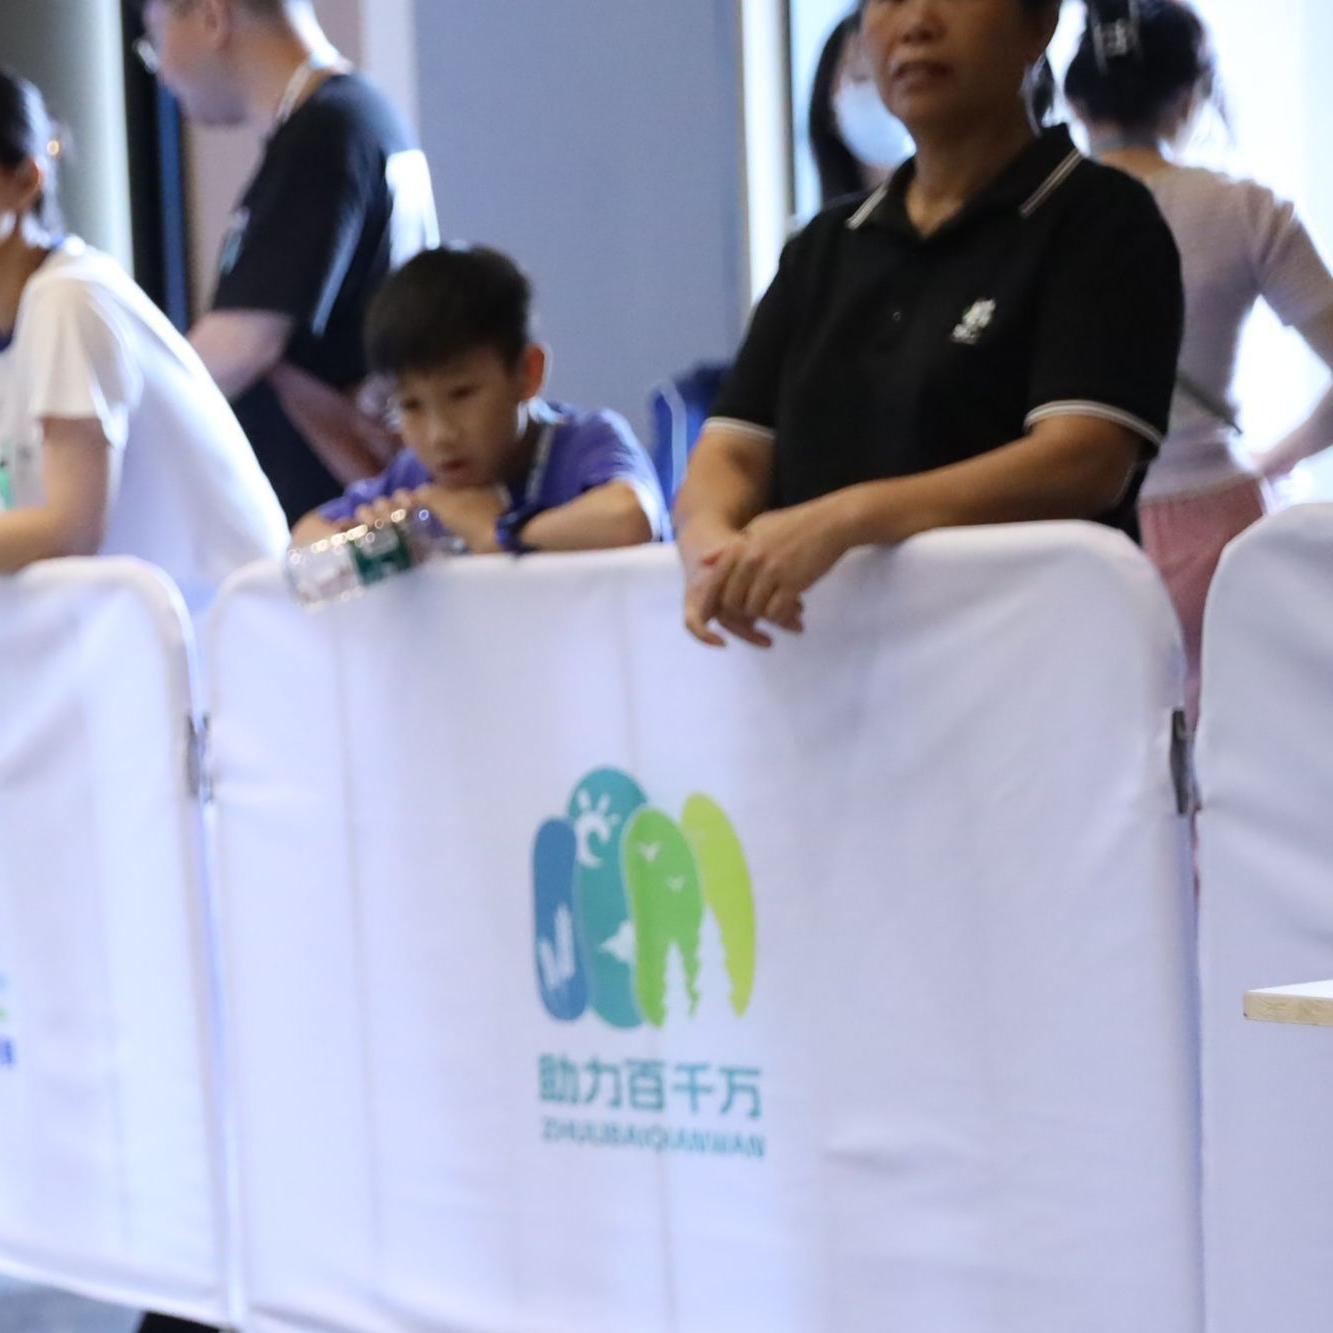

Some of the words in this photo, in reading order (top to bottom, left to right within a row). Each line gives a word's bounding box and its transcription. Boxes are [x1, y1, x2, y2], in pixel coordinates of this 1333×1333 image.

[538, 1053, 763, 1121] 助力百千万
